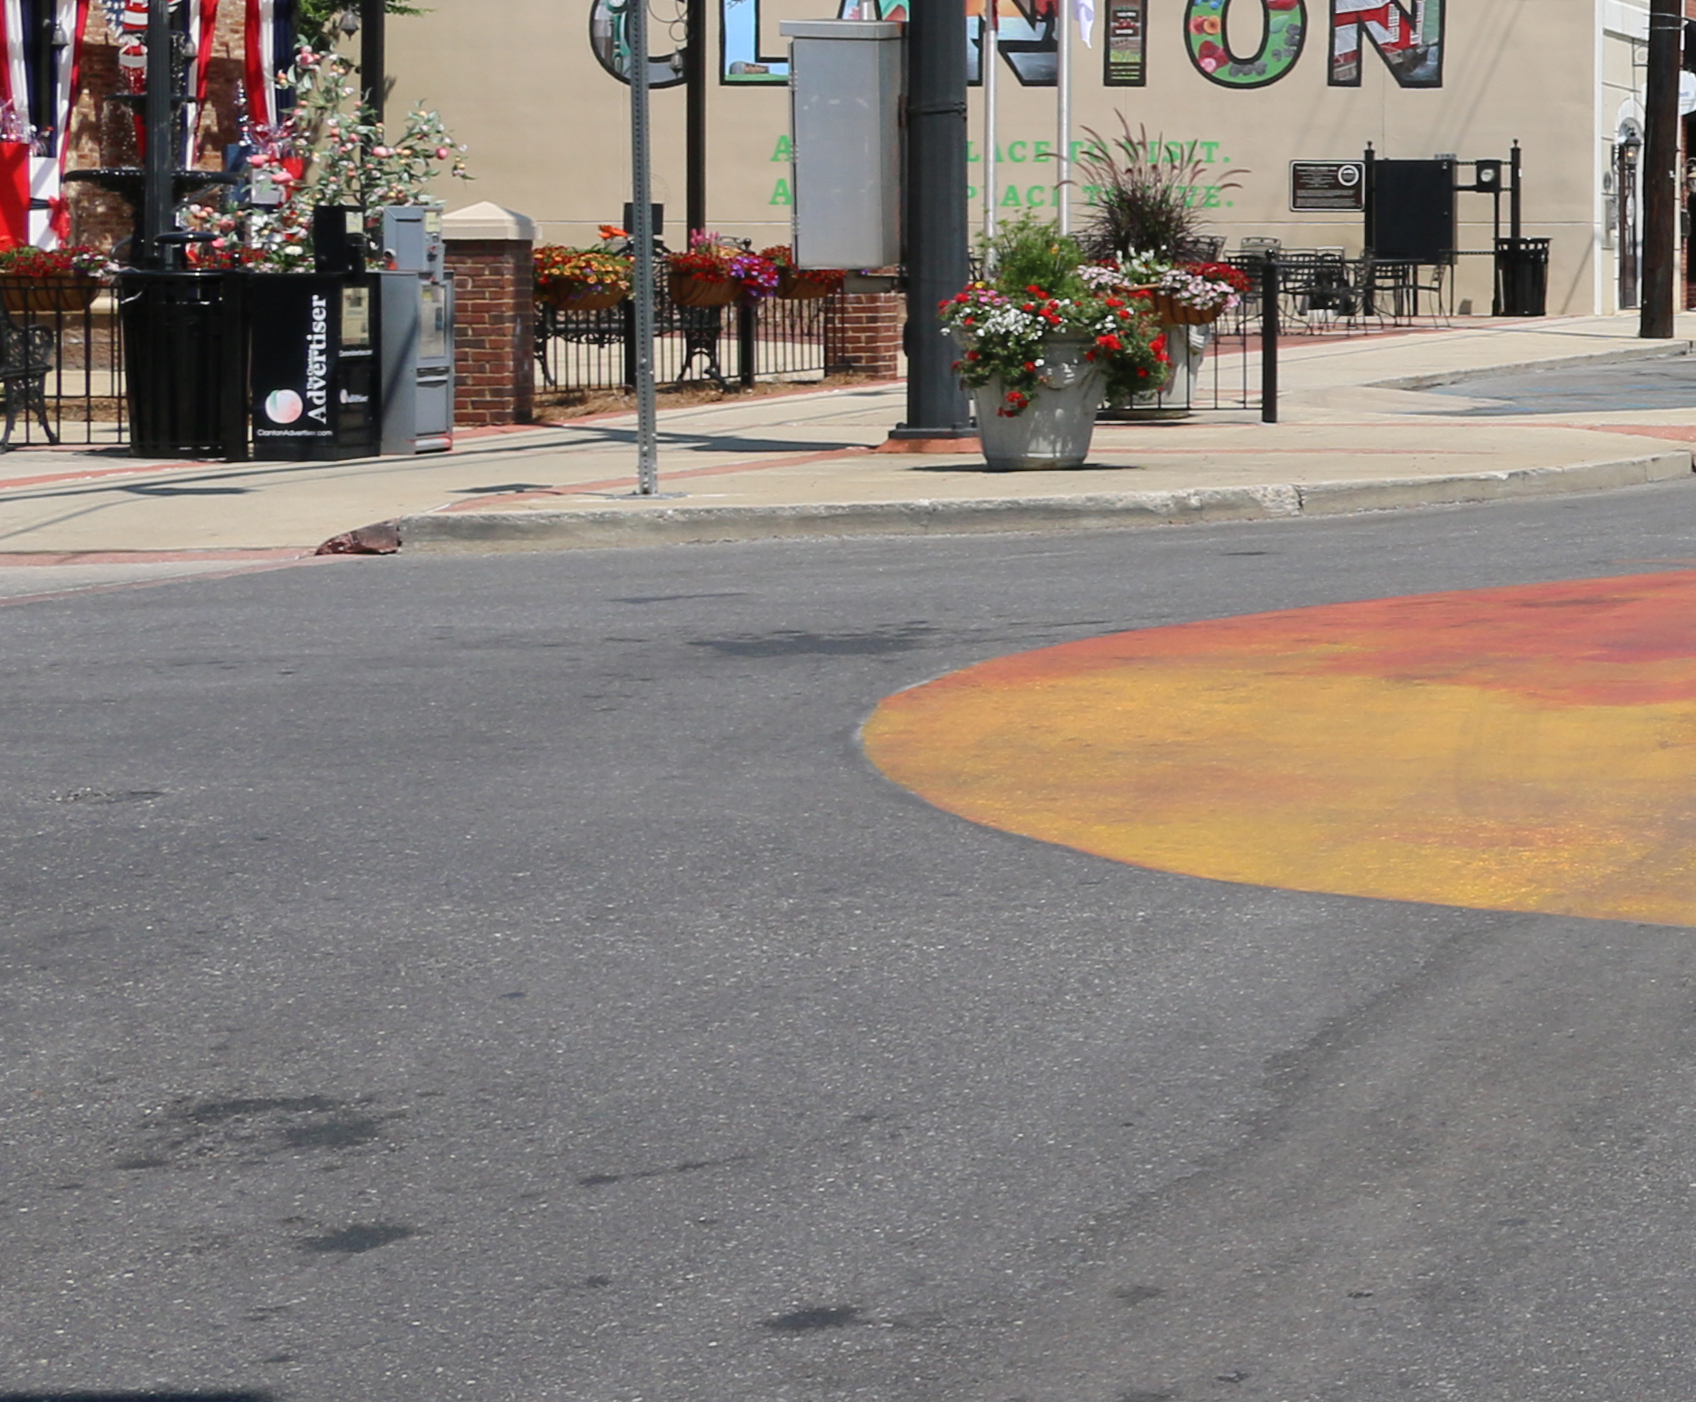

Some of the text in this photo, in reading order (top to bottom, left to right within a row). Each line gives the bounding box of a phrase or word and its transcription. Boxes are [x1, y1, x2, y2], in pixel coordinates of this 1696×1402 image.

[770, 135, 792, 162] A
[966, 140, 1051, 163] LCE
[768, 179, 792, 205] A
[306, 295, 327, 424] Advertiser
